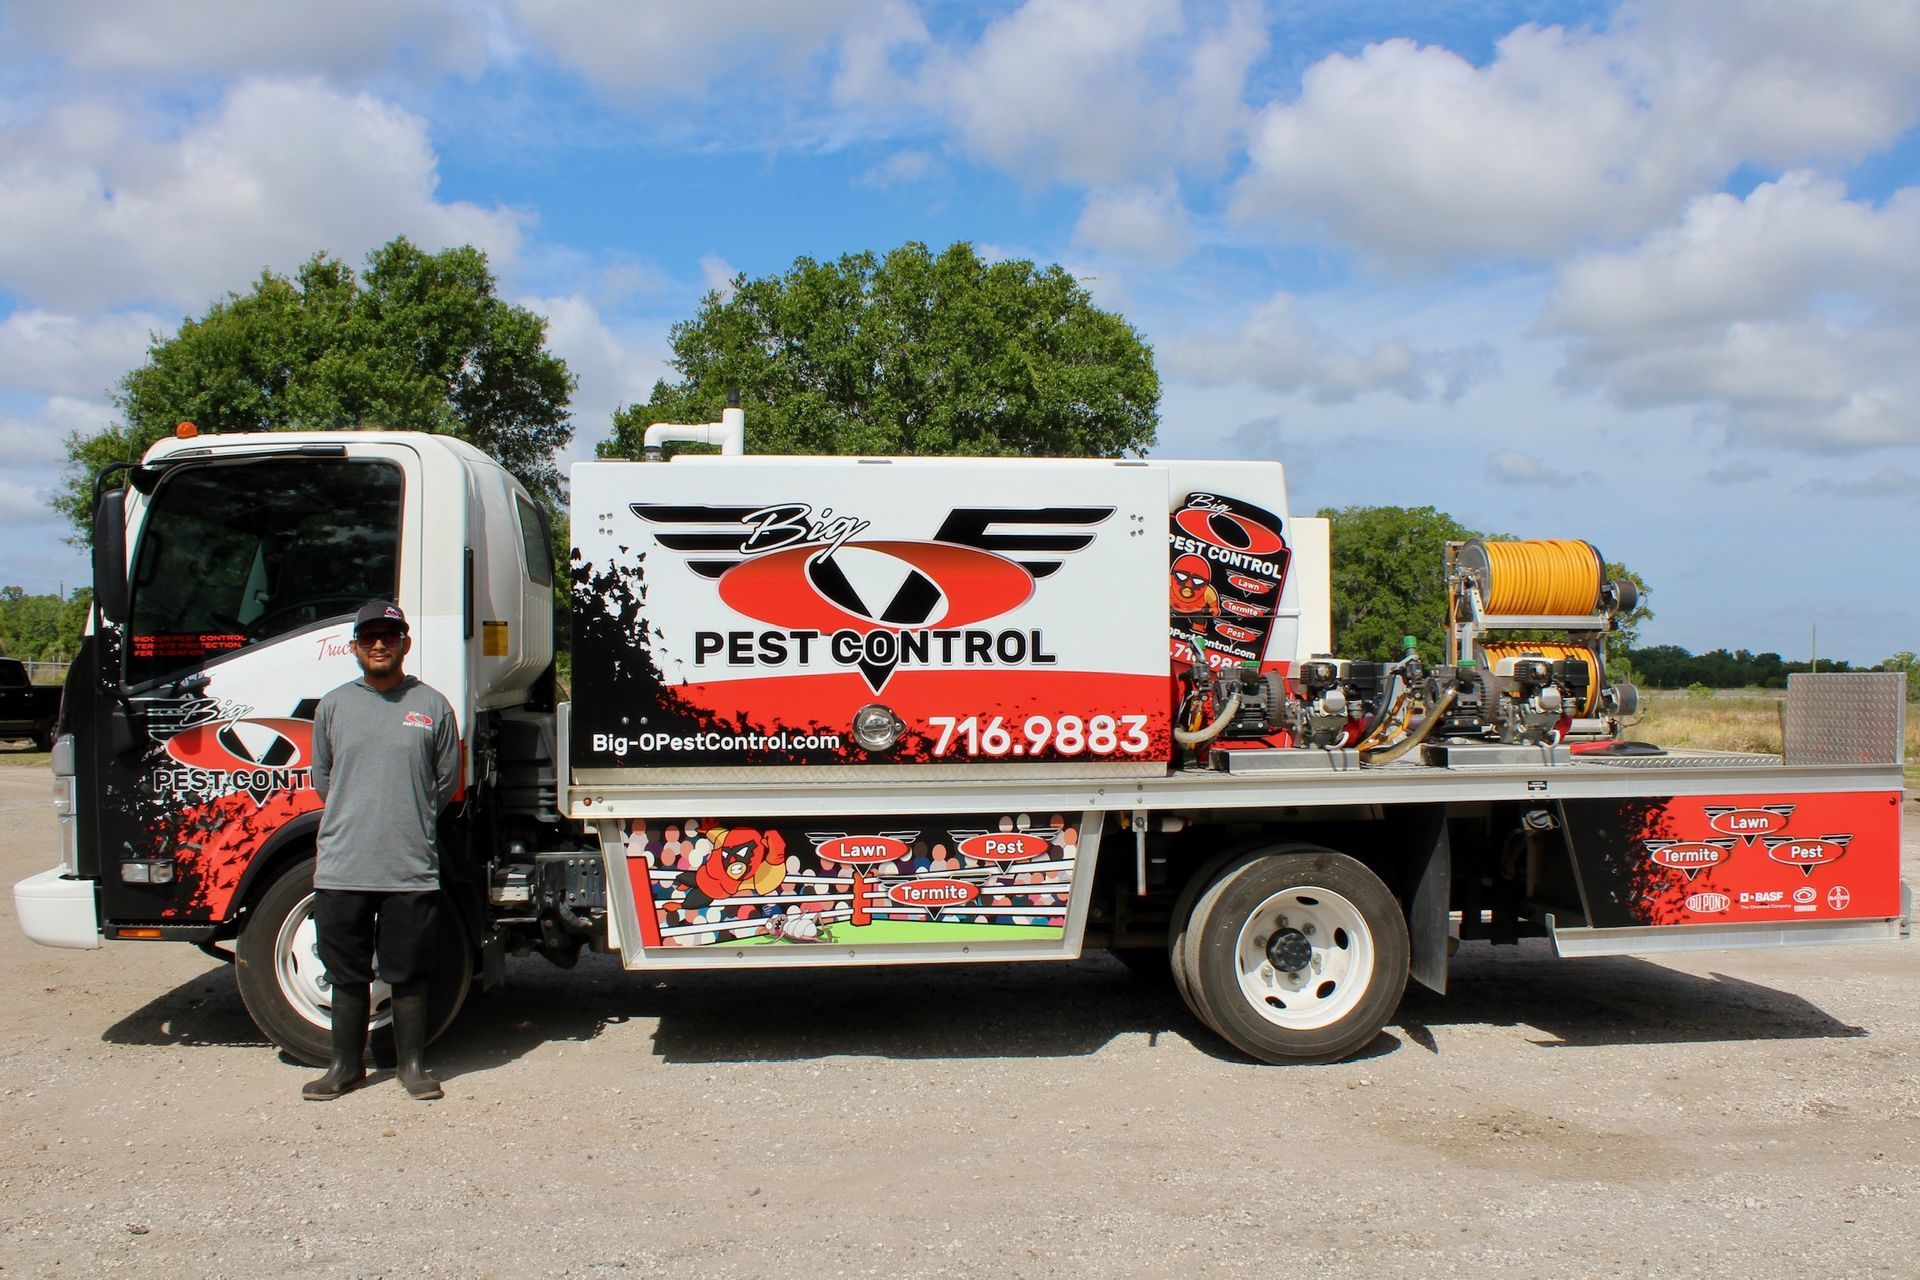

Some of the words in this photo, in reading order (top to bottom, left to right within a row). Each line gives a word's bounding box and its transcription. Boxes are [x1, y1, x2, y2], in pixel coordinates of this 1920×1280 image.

[1188, 494, 1232, 518] Big
[739, 502, 869, 565] Big
[1207, 545, 1282, 579] CONTROL
[1238, 579, 1259, 591] Lawn
[1228, 602, 1258, 616] Termite
[199, 634, 247, 642] CONTROL
[1226, 627, 1245, 639] Pest
[317, 634, 353, 661] Truc
[693, 629, 819, 667] PEST
[830, 629, 1058, 667] CONTROL
[180, 697, 254, 733] Big
[928, 714, 1150, 756] 716.9883
[592, 732, 840, 757] Big-OPestControl.com
[153, 768, 226, 792] PEST
[232, 768, 316, 791] CONT
[1730, 815, 1769, 830] Lawn
[840, 842, 887, 859] Lawn
[985, 839, 1024, 855] Pest
[1663, 849, 1719, 862] Termite
[1791, 845, 1823, 859] Pest
[901, 884, 969, 901] Termite
[1755, 891, 1784, 902] BASF
